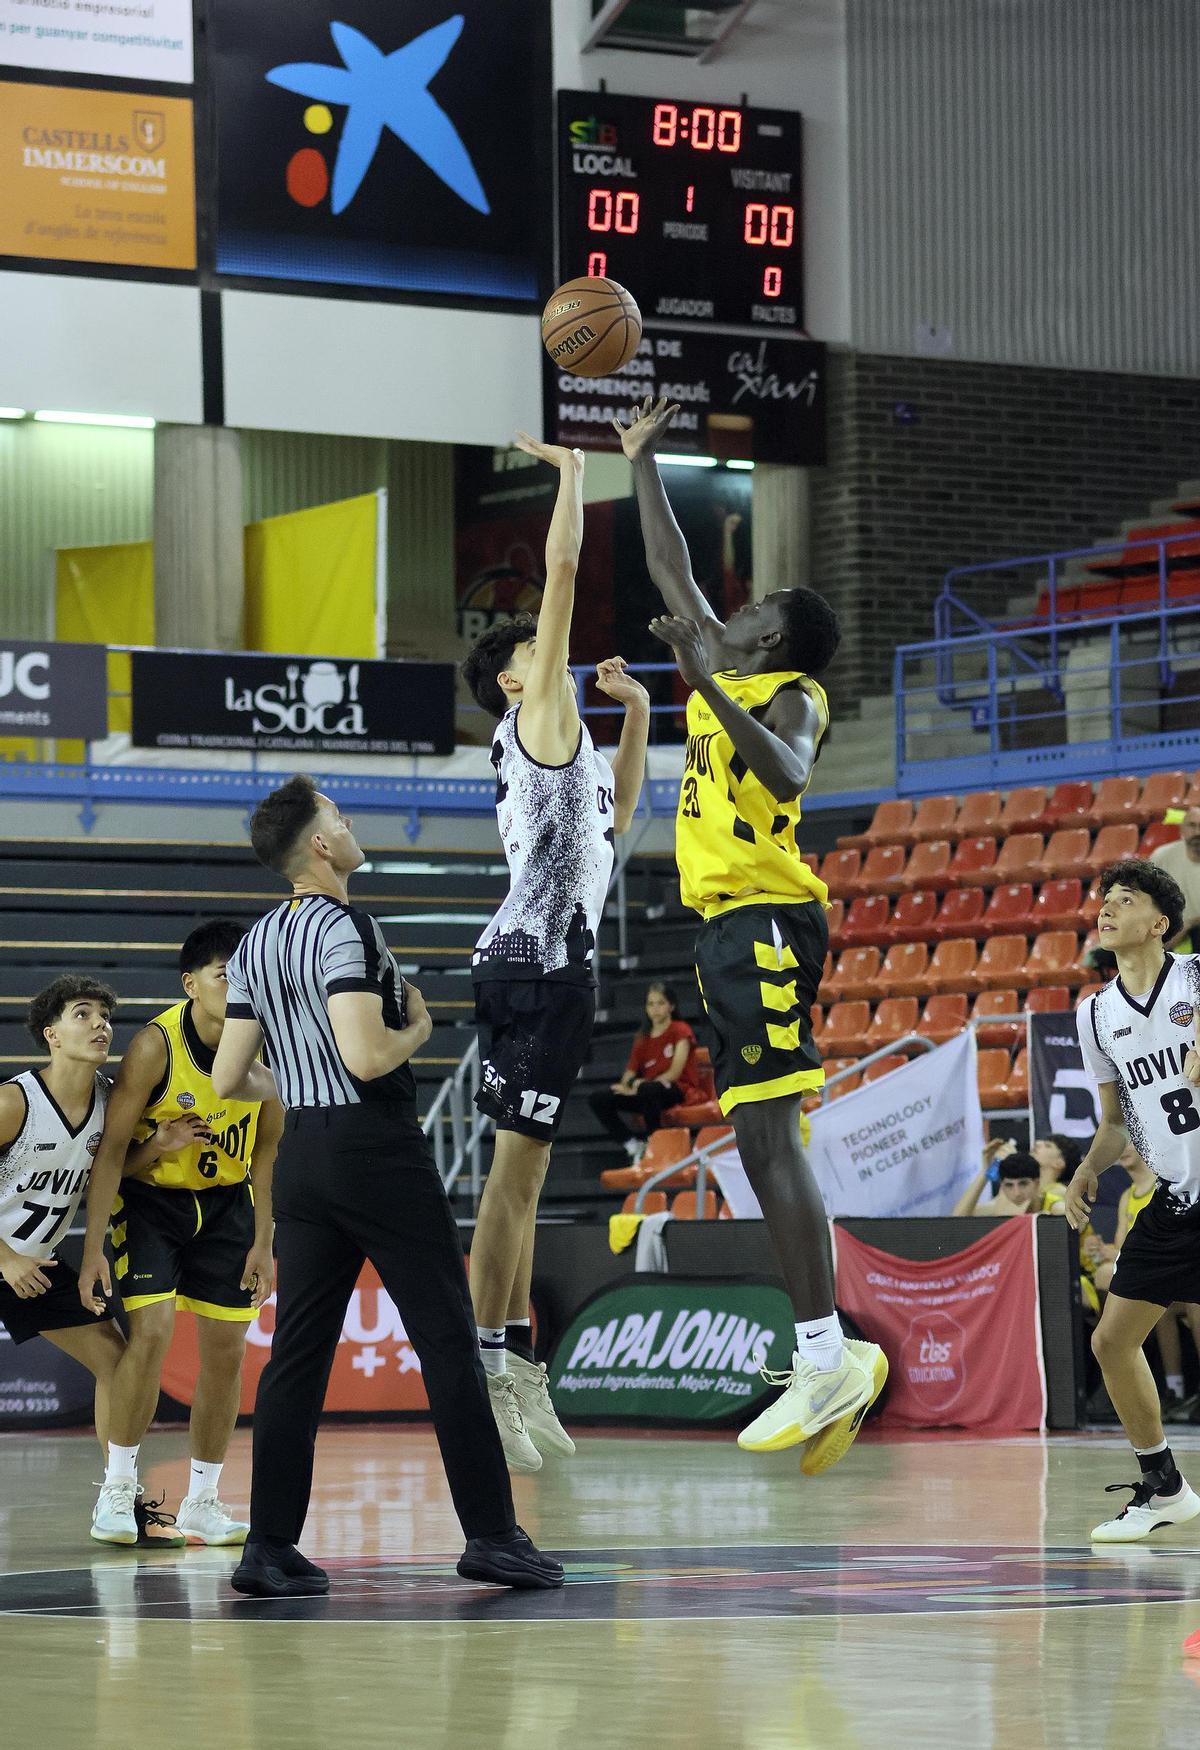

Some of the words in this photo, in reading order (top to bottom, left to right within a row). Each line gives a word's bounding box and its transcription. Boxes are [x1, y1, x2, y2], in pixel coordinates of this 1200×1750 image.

[23, 126, 129, 152] CASTELLS
[653, 104, 742, 152] 8:00
[23, 147, 165, 178] IMMERSCOM
[572, 153, 637, 177] LOCAL
[730, 168, 792, 193] VISITANT
[588, 189, 640, 234] 00
[685, 185, 695, 213] 1
[744, 203, 794, 247] 00
[763, 266, 782, 297] 0
[655, 297, 714, 318] JUGADOR
[752, 304, 796, 324] FALTES
[1126, 1040, 1195, 1090] JOVIA
[520, 1089, 560, 1125] 12
[841, 1096, 932, 1149] TECHNOLOGY
[1160, 1088, 1200, 1135] 8
[850, 1128, 907, 1164] PIONEER
[858, 1166, 873, 1181] IN
[875, 1142, 919, 1173] CLEAN
[920, 1115, 966, 1151] ENERGY
[197, 1150, 218, 1179] 6
[11, 1200, 71, 1244] 77
[567, 1310, 664, 1370] PAPA
[650, 1308, 776, 1376] JOHNS
[0, 1378, 57, 1393] onfiança
[556, 1374, 602, 1393] Mejores
[677, 1374, 714, 1394] Mejor
[908, 1366, 956, 1384] EDUCATION
